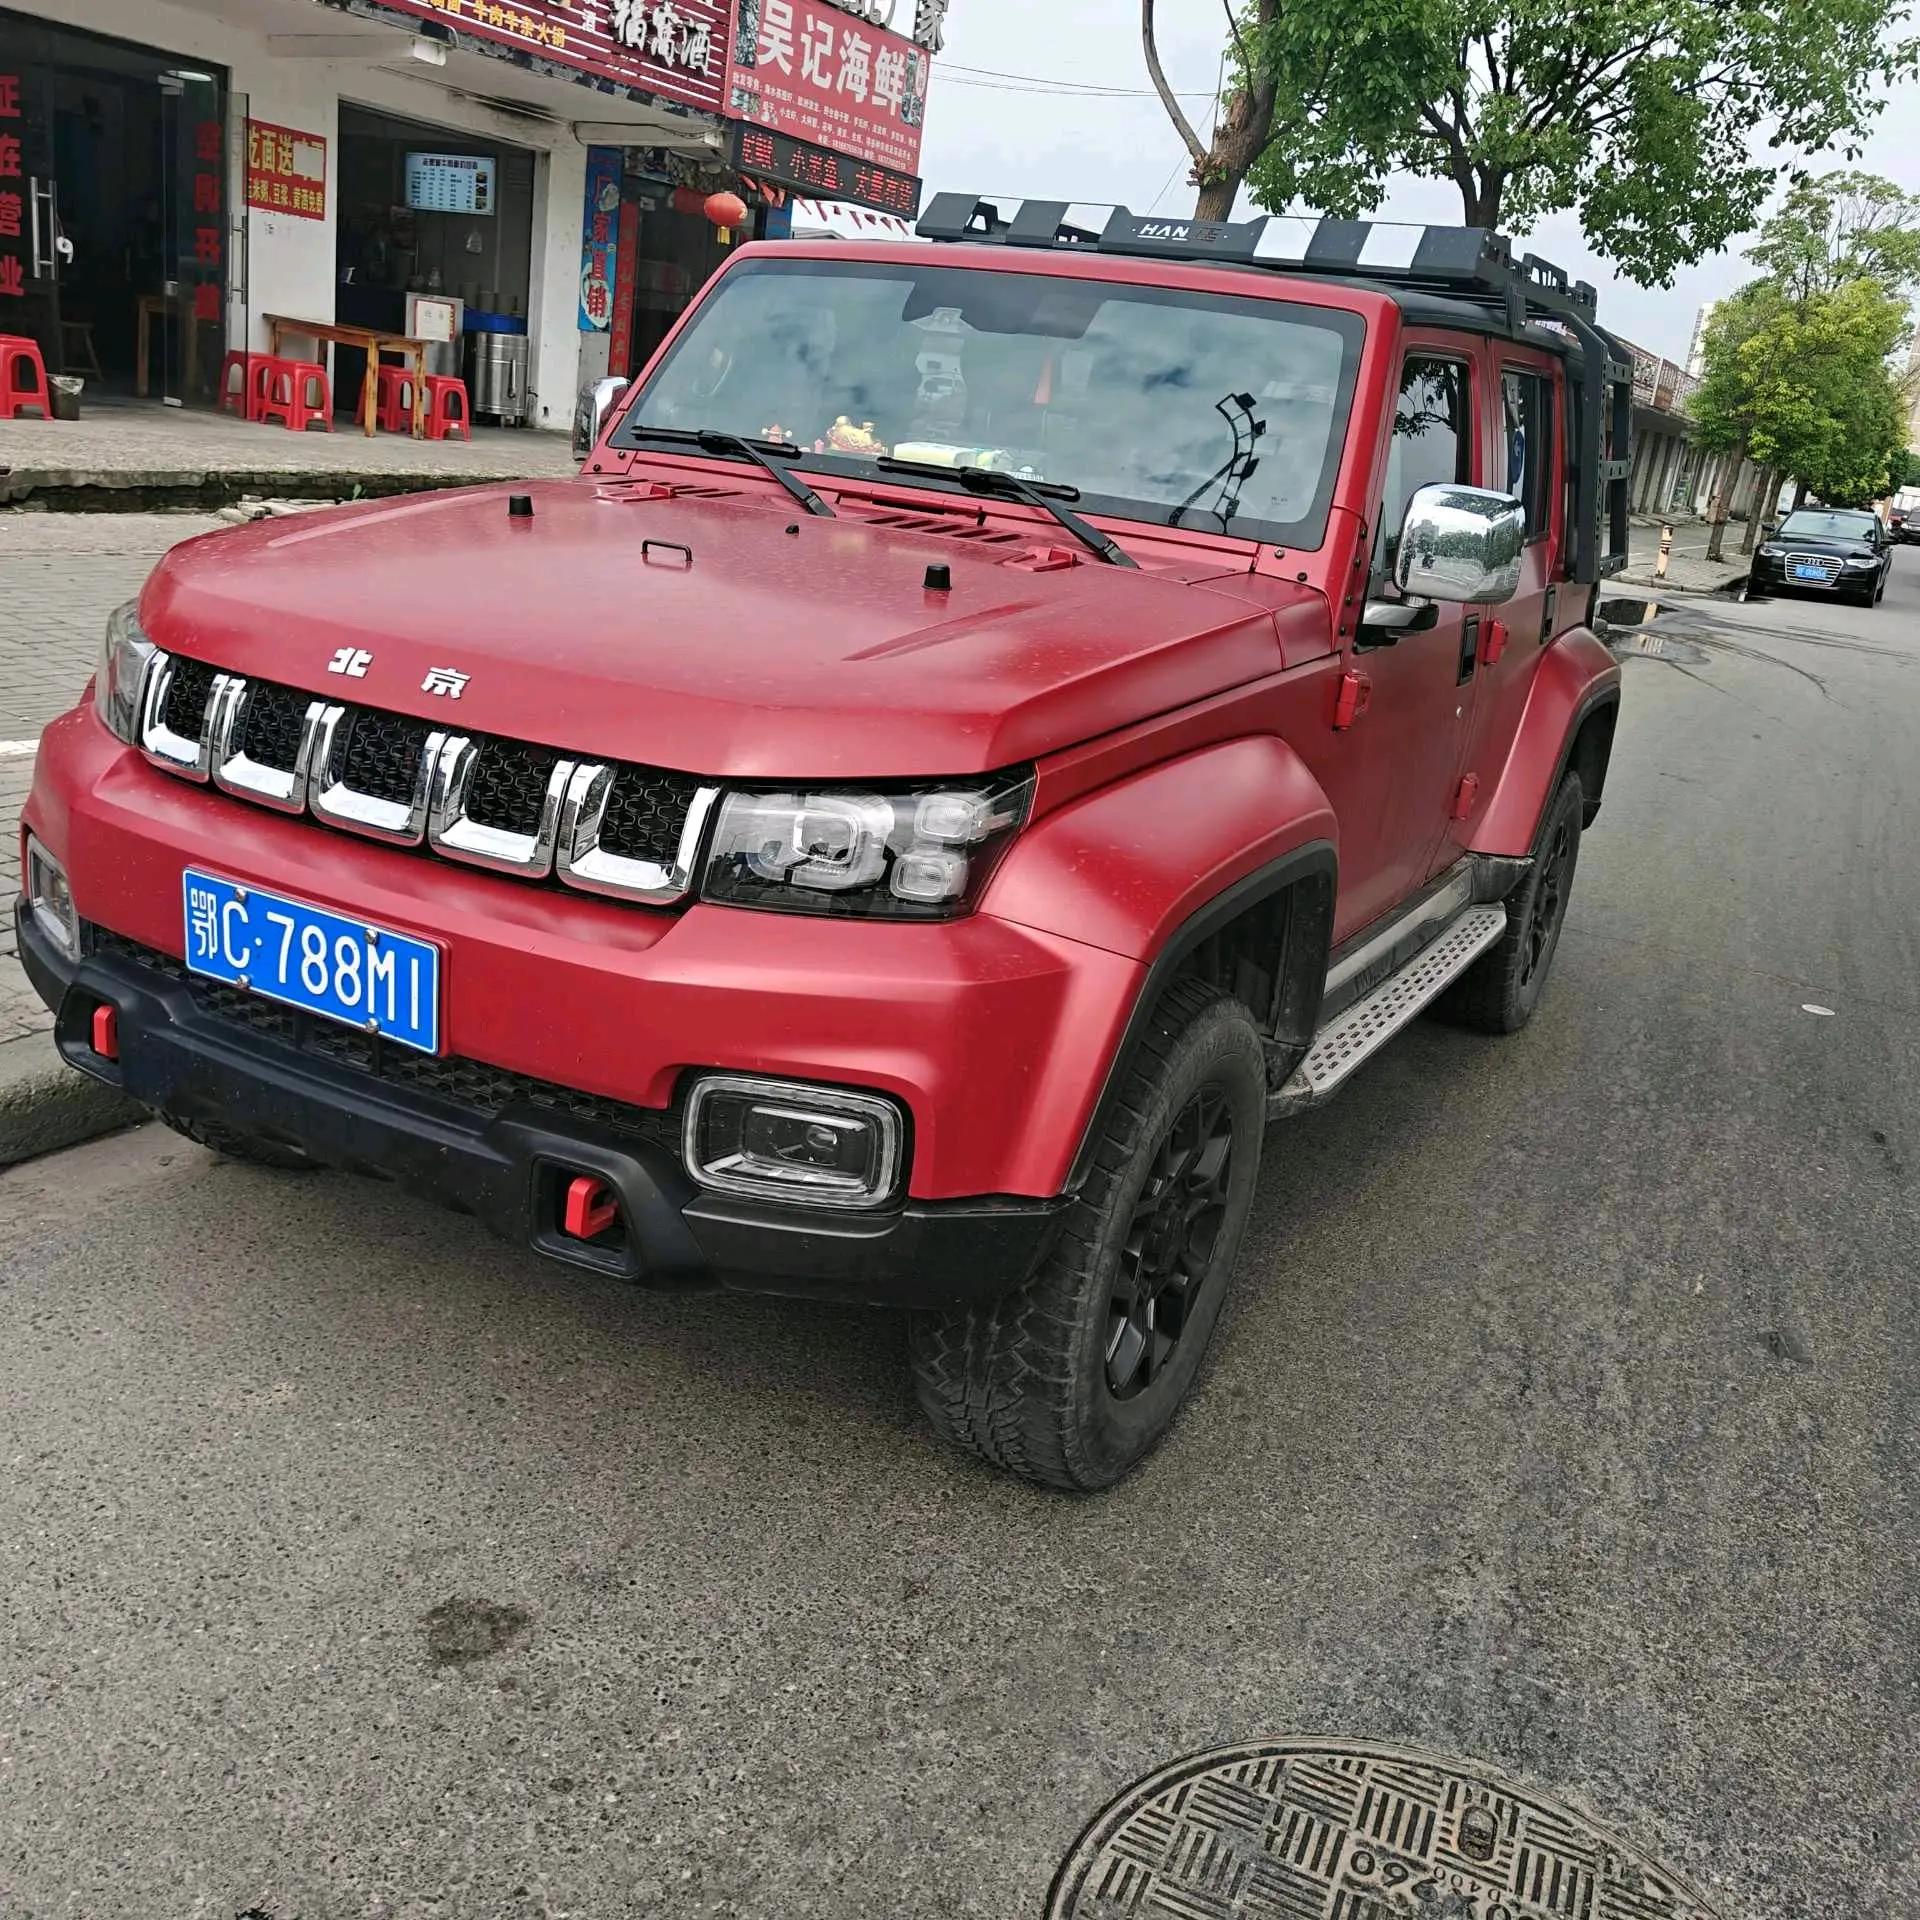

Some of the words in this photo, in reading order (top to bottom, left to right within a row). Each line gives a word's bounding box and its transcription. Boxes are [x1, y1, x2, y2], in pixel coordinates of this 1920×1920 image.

[757, 0, 905, 116] 吴记海鲜
[0, 75, 24, 296] 正在营业
[247, 124, 325, 182] 吃面送
[328, 647, 471, 699] 北京
